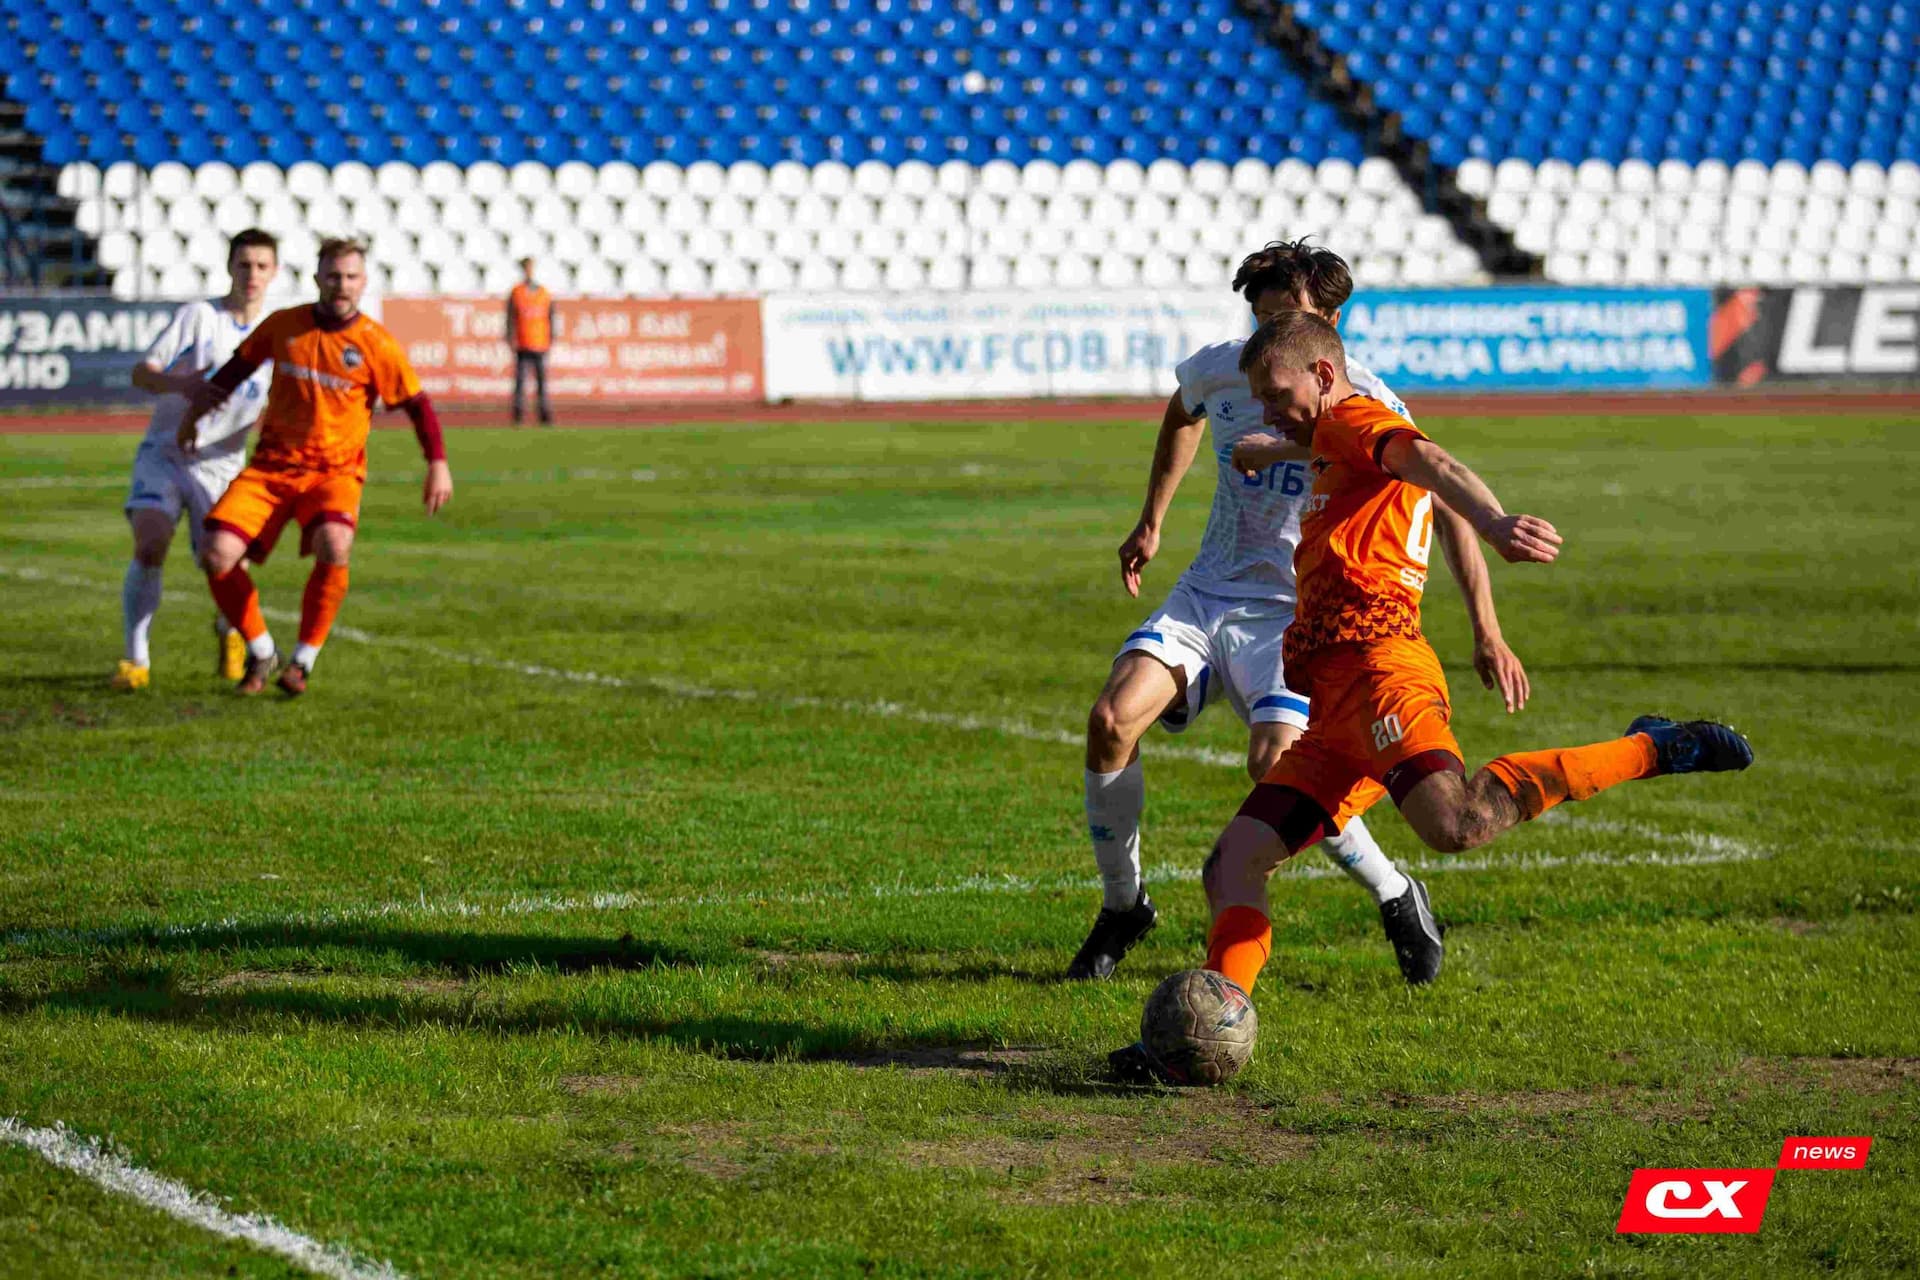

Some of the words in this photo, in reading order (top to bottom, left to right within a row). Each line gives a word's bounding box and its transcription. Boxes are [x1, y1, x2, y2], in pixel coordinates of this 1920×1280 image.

[1344, 302, 1688, 341] АДМИНИСТРАЦИЯ
[1499, 338, 1696, 374] БАРНАУЛА
[1371, 714, 1403, 753] 20
